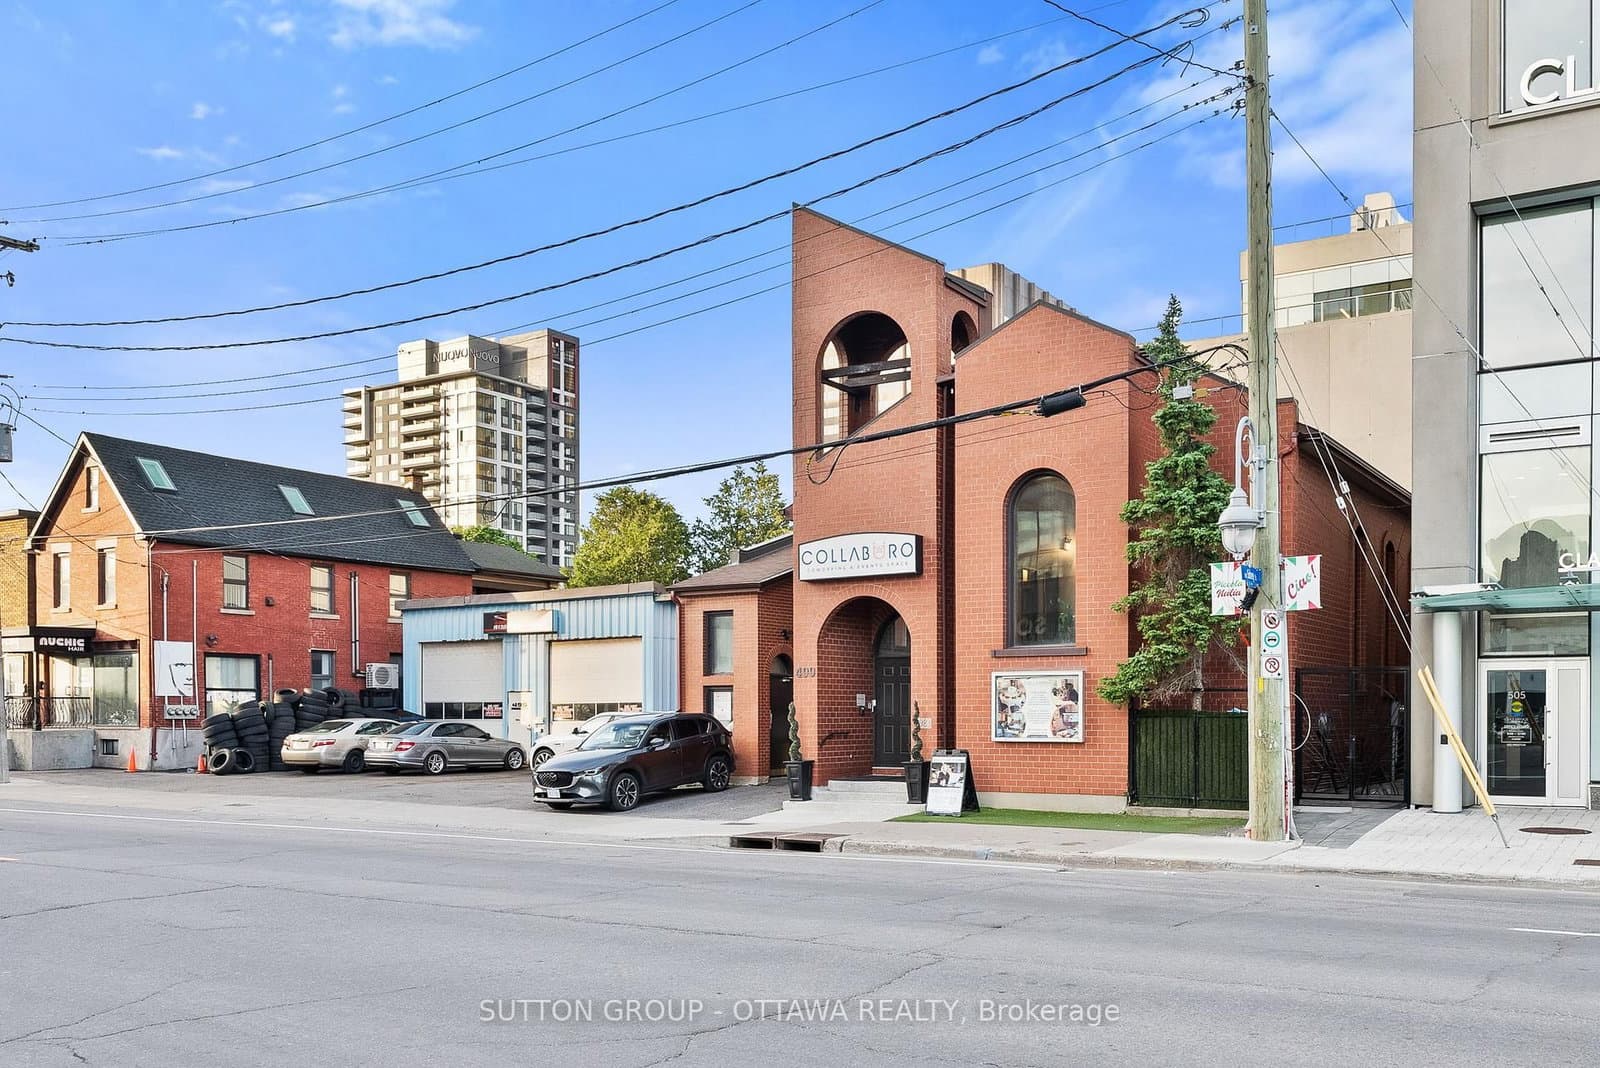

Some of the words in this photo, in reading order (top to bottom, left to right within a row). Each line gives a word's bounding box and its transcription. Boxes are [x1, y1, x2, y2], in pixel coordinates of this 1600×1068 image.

[432, 347, 469, 363] NUOVO
[470, 348, 500, 364] NUOVO
[1507, 690, 1526, 700] 505
